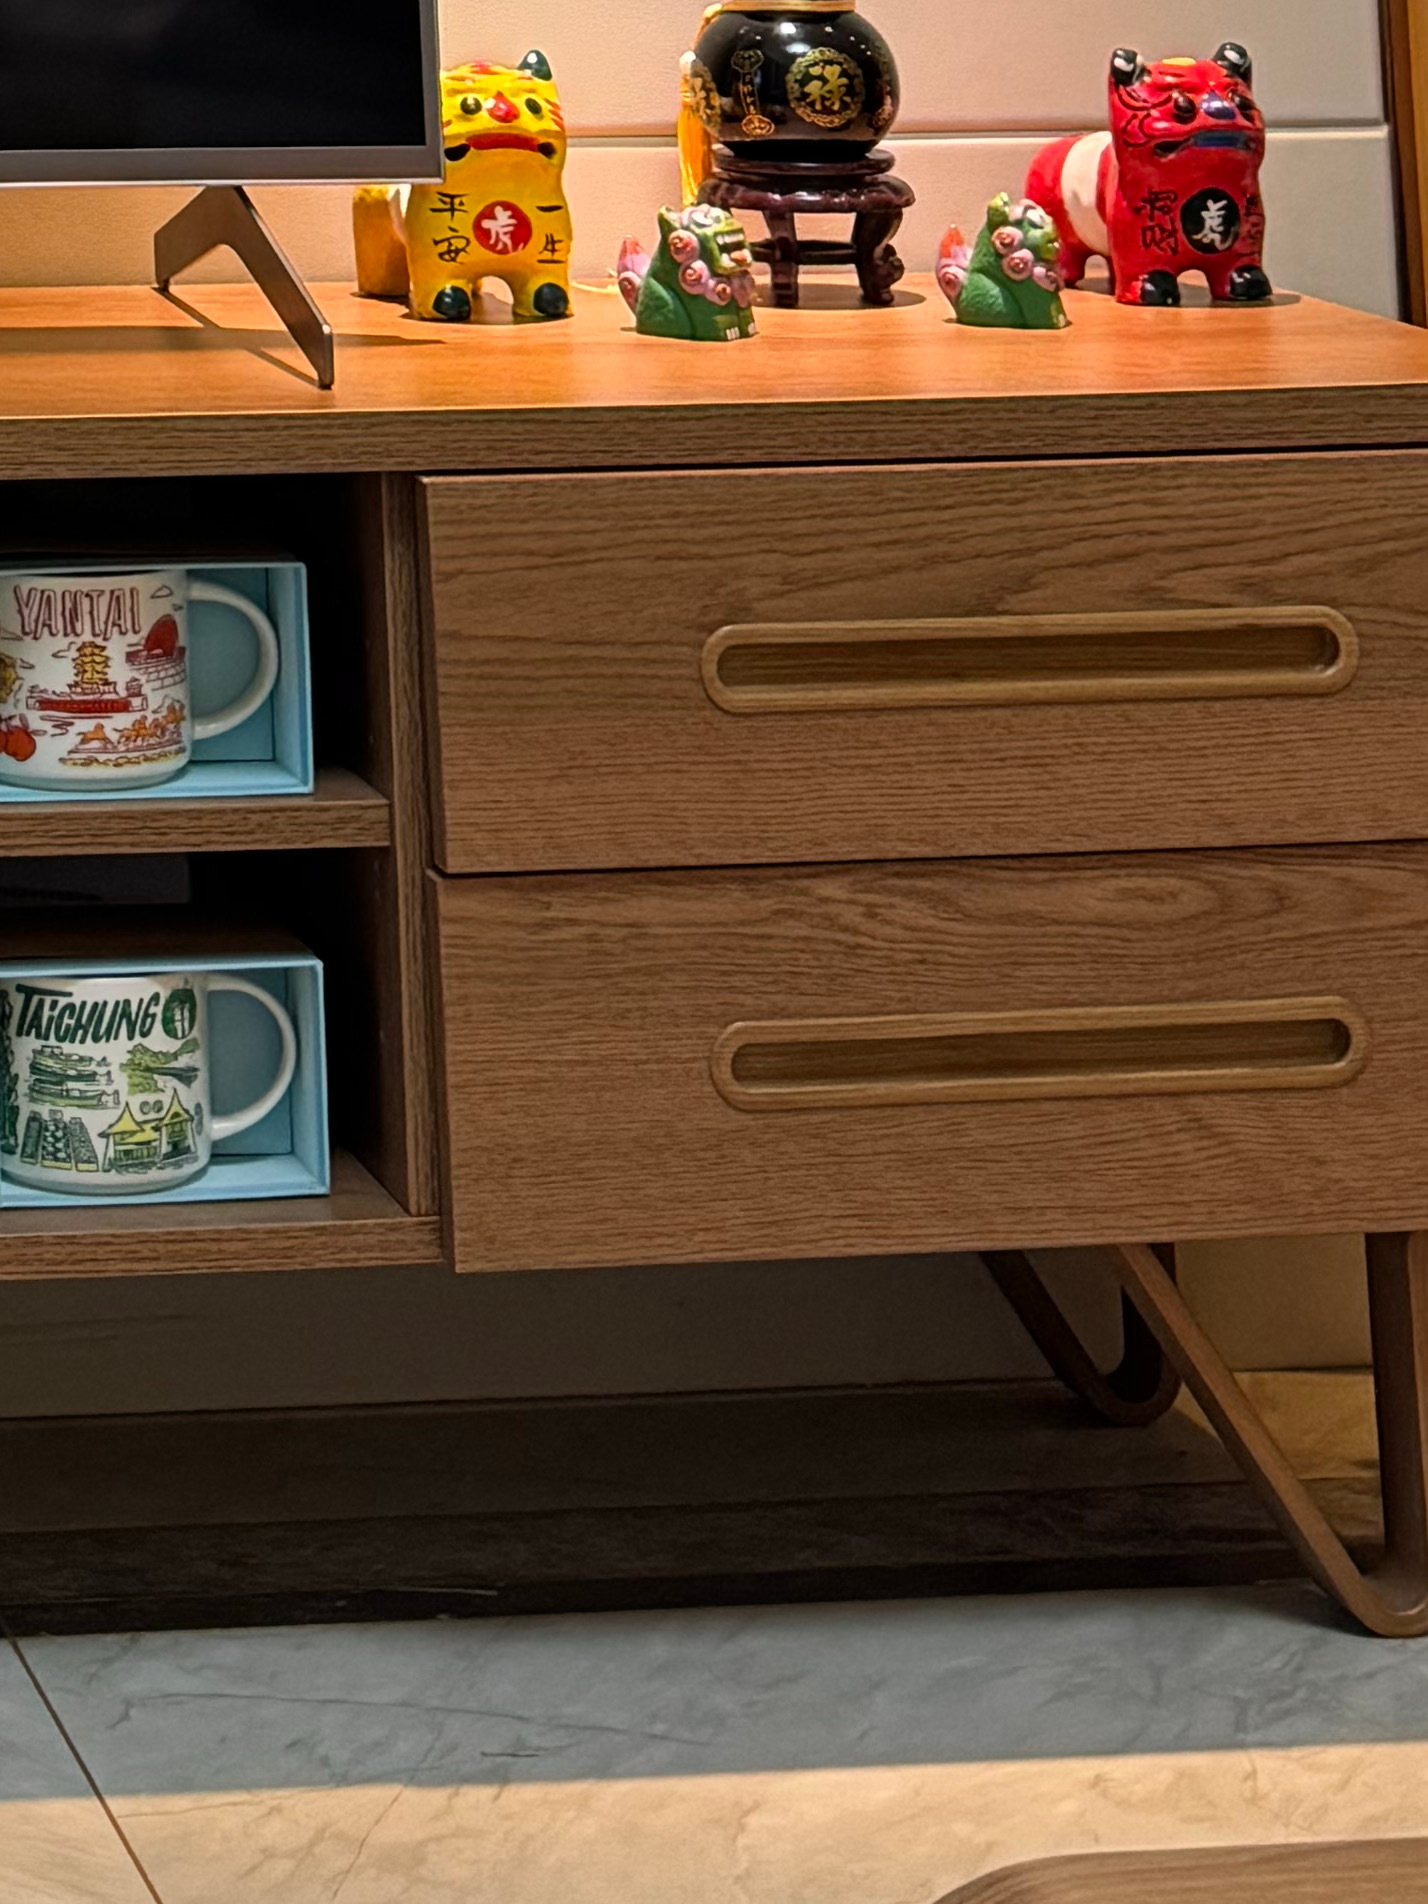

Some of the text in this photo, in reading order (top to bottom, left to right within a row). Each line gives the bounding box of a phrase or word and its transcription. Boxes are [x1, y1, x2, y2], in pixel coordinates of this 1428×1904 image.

[429, 191, 471, 265] 平安
[481, 205, 525, 254] 虎
[536, 205, 567, 264] 一生
[13, 584, 142, 642] YANTAI
